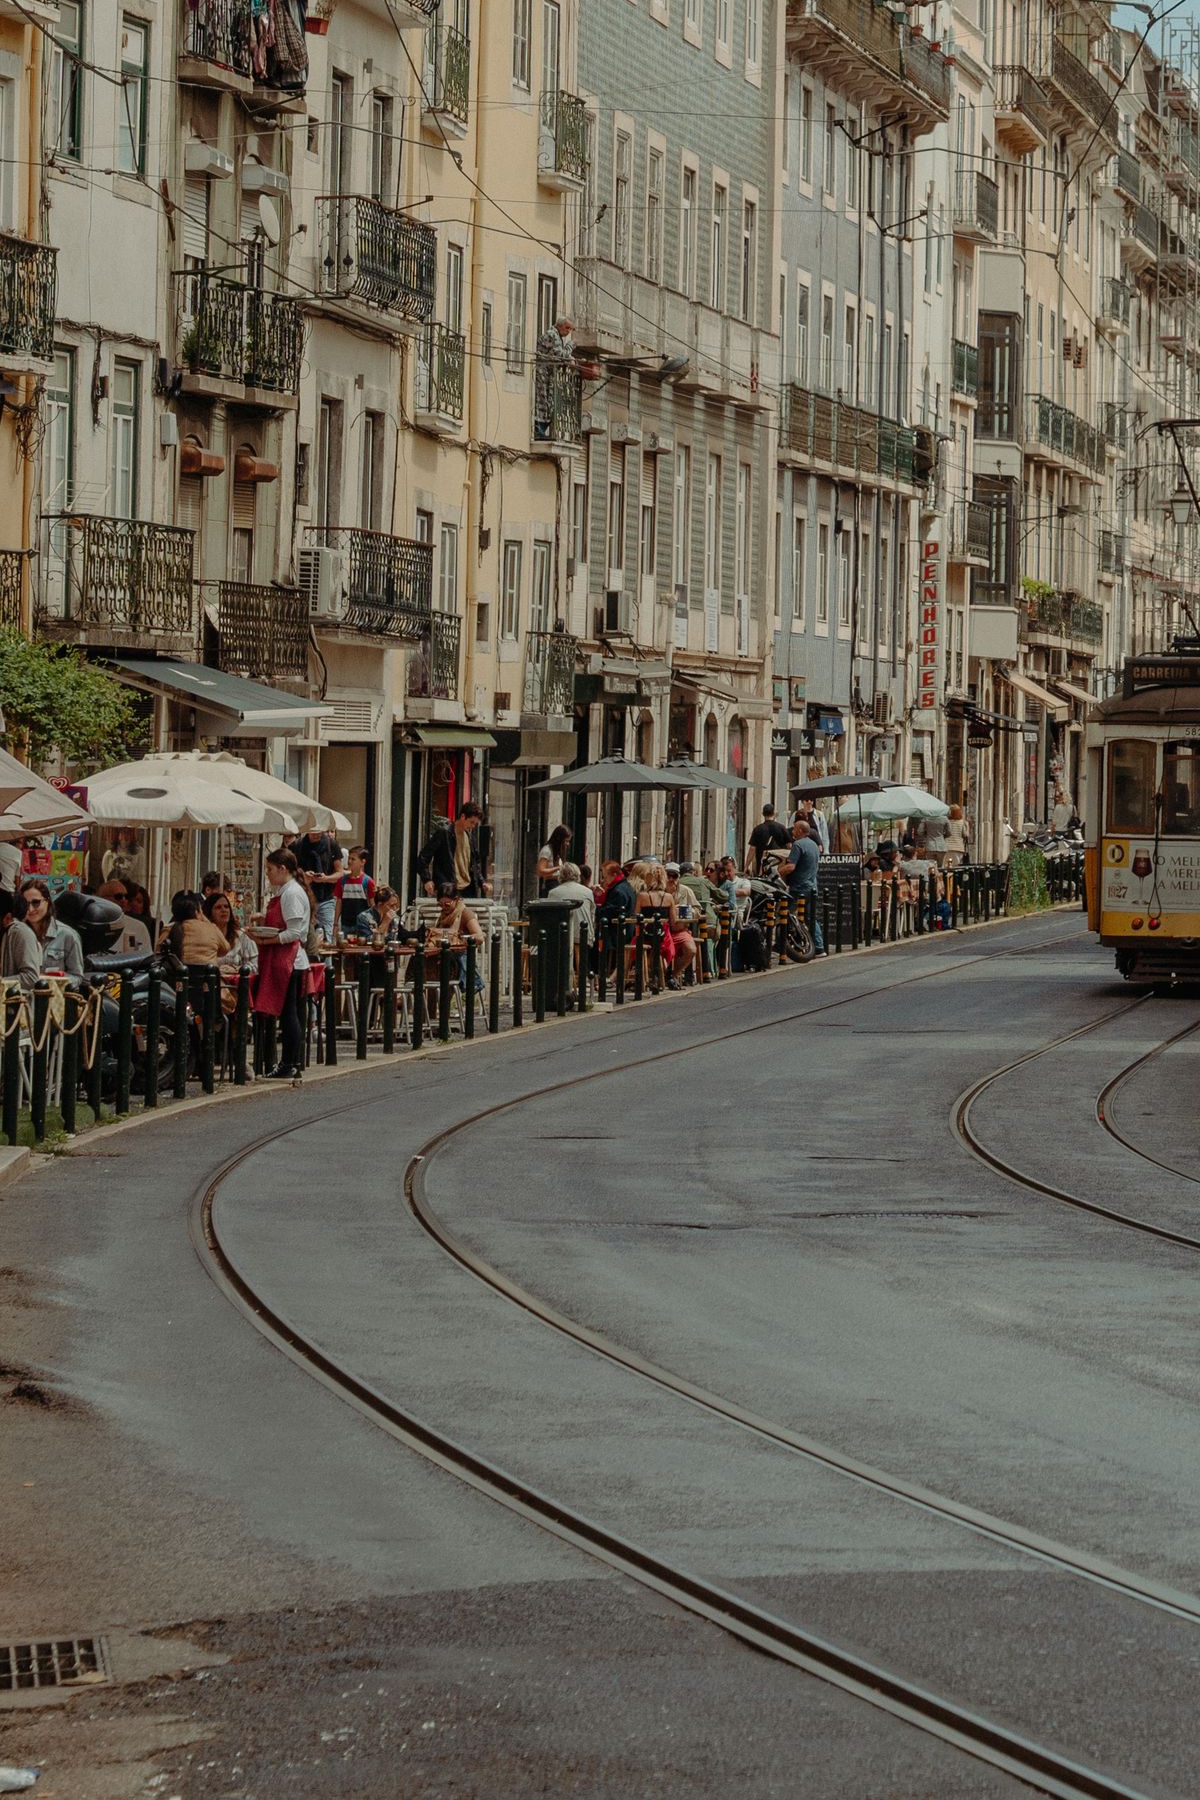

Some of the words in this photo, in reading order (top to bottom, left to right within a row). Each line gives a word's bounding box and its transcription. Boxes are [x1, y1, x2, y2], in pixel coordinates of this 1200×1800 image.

[921, 541, 939, 708] PENHORES
[967, 737, 993, 746] TATTOO
[818, 855, 860, 864] ACALHAU
[1156, 855, 1166, 866] O
[1157, 881, 1166, 891] A
[1107, 886, 1128, 899] 1927
